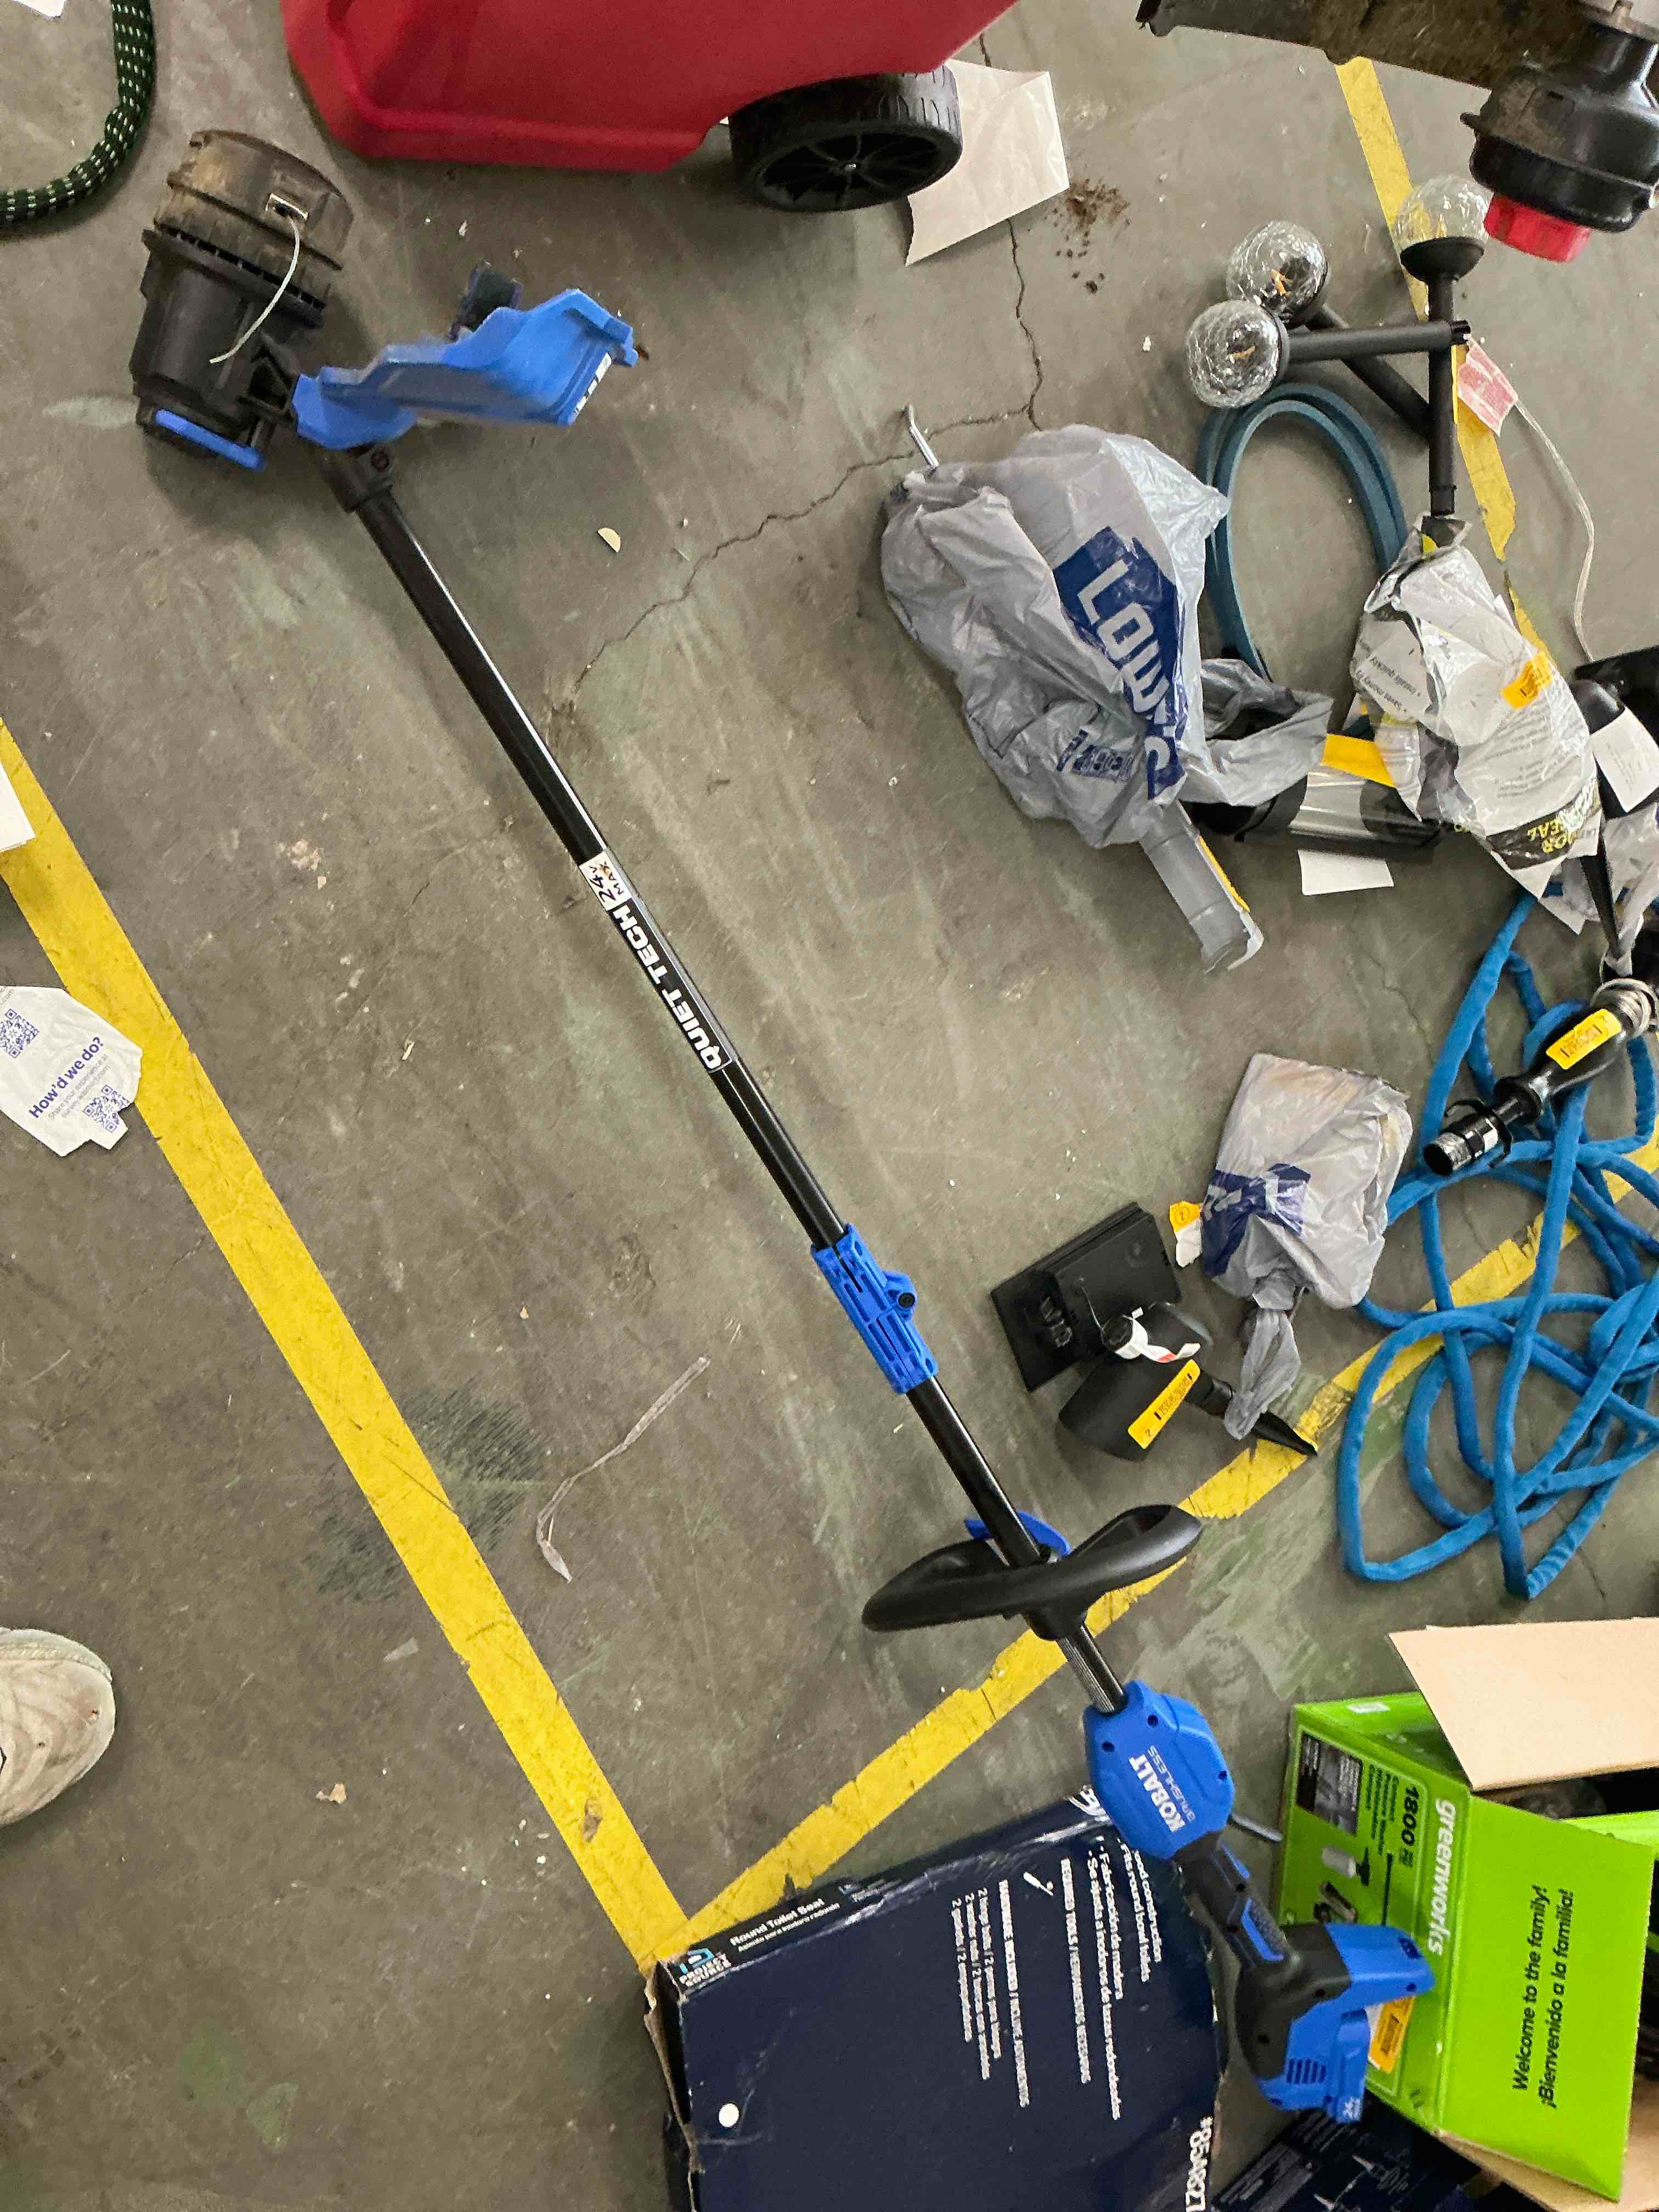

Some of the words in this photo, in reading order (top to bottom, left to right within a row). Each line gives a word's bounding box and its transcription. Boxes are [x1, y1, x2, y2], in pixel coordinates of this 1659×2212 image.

[1077, 559, 1174, 772] LOW'S
[599, 860, 624, 895] MAX
[612, 904, 671, 985] TECH
[661, 989, 724, 1071] QUIET
[28, 1075, 68, 1119] How'd
[64, 1058, 85, 1081] we
[78, 1035, 105, 1063] do?
[1127, 1753, 1186, 1832] KOBALT
[1398, 1785, 1421, 1847] 1800
[978, 1888, 988, 1897] 2
[1087, 1857, 1099, 1879] Se
[1127, 1871, 1143, 1912] round
[1427, 1799, 1455, 1955] greenworks
[730, 1923, 768, 1946] Round
[766, 1910, 798, 1929] Toilet
[797, 1898, 825, 1916] Seat
[951, 1898, 961, 1908] 2
[957, 1953, 967, 1963] 2
[964, 1893, 974, 1903] 2
[972, 1968, 981, 1978] 2
[1065, 1912, 1078, 1944] TOOLS
[1135, 1911, 1149, 1944] bowl
[1141, 1878, 1162, 1963] construction
[1527, 1883, 1550, 1946] family!
[1552, 1888, 1573, 1957] familia!
[1096, 1930, 1109, 1985] inodoros
[1109, 1933, 1122, 1950] de
[1139, 1944, 1150, 1982] toilets
[1522, 1950, 1542, 1980] the
[1100, 1986, 1113, 2003] de
[1109, 1950, 1126, 2000] madera
[1521, 1983, 1538, 2003] to
[1550, 1961, 1567, 1979] la
[1551, 1982, 1565, 1996] a
[1511, 2007, 1535, 2090] Welcome
[1537, 1999, 1563, 2108] ¡Bienvenido
